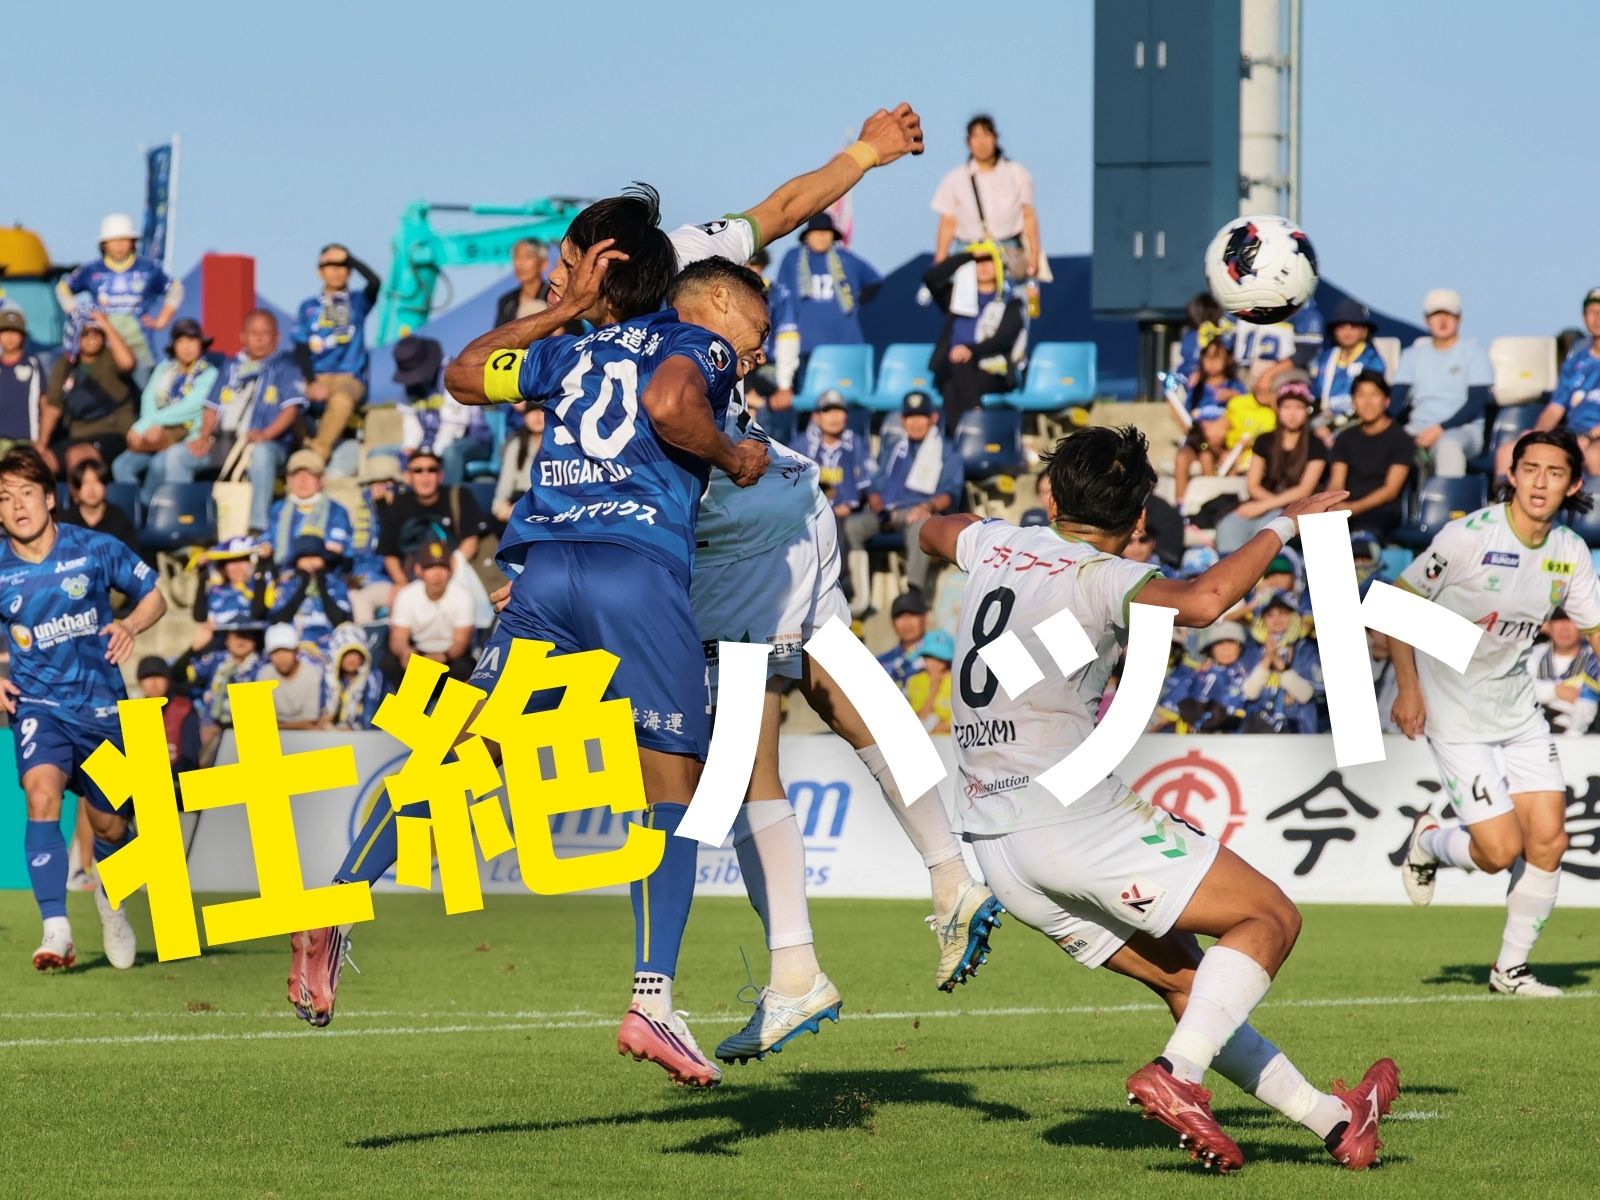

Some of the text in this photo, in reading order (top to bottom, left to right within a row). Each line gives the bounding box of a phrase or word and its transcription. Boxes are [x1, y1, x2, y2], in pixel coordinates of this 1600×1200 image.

[1244, 330, 1281, 361] 12
[492, 352, 518, 371] C
[553, 350, 639, 460] 10
[552, 500, 658, 526] ザイマックス
[959, 586, 1016, 709] 8
[20, 717, 38, 747] 9
[954, 720, 1016, 749] OIZUMI
[1471, 774, 1494, 806] 4
